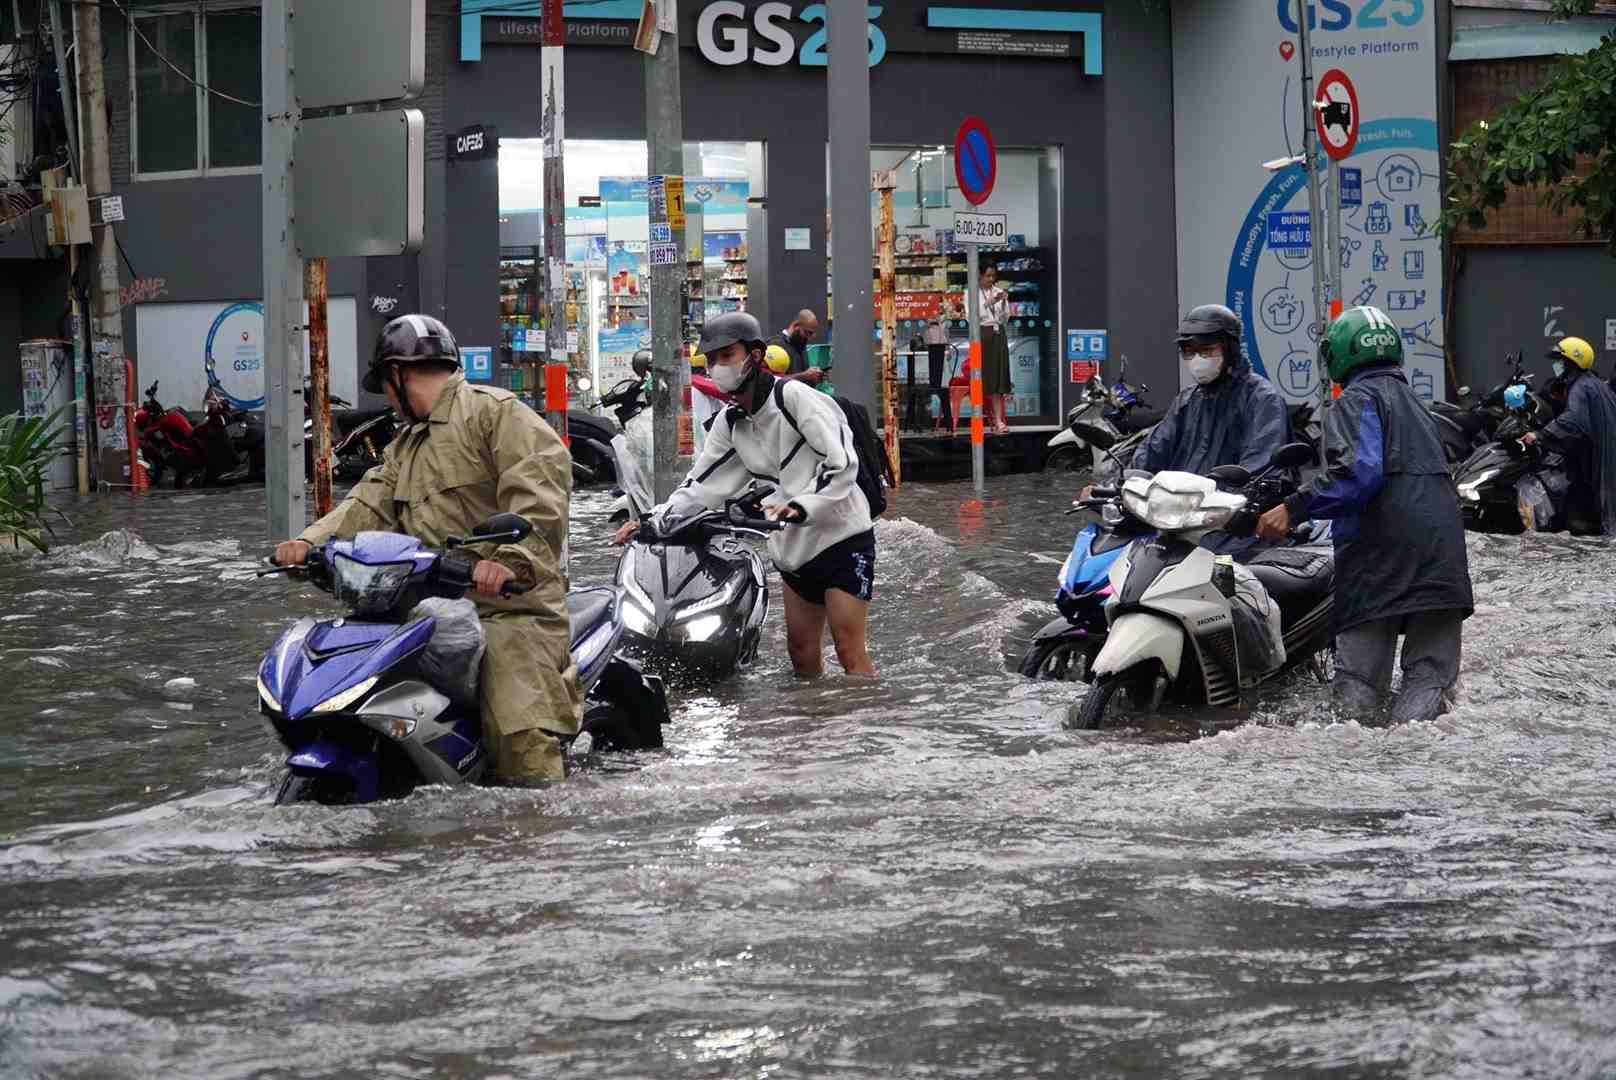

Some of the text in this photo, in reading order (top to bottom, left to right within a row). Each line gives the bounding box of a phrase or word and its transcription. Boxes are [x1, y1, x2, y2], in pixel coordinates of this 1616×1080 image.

[499, 21, 630, 37] Lifest Platform
[1311, 39, 1420, 60] festyle Platform
[1360, 330, 1396, 347] Grab
[233, 359, 260, 372] GS25
[1197, 614, 1227, 625] HONDA
